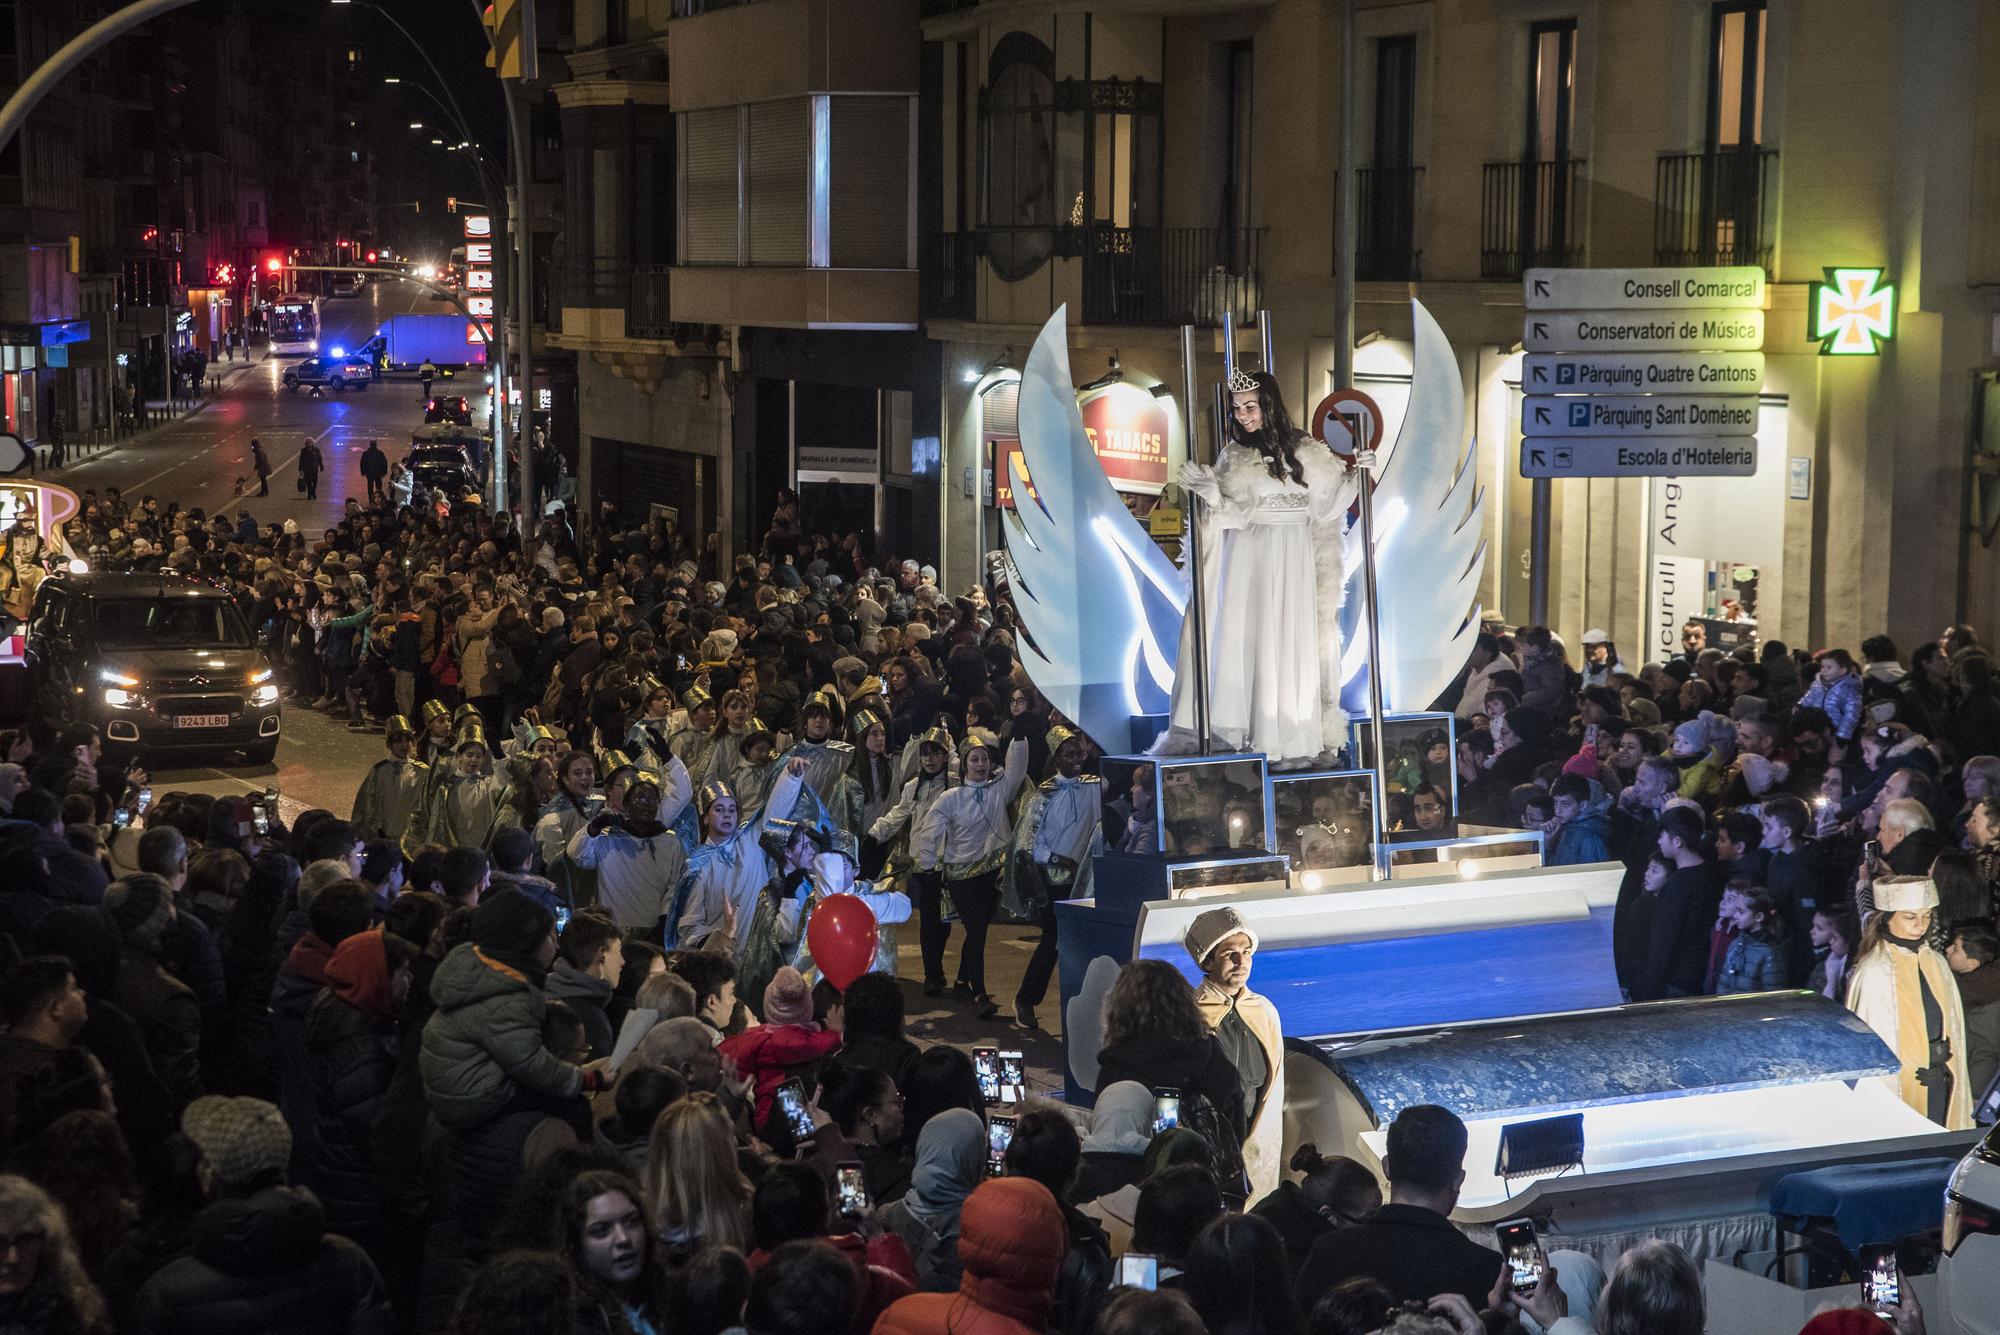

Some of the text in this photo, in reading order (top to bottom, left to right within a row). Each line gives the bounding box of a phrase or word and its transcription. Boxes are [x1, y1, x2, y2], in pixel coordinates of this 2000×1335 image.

[1624, 279, 1756, 298] Consell Comarcal
[1577, 321, 1756, 340] Conservatori de Música
[1560, 364, 1756, 387] P Pàrquing Quatre Cantons
[1572, 404, 1752, 429] P Pàrquing Sant Domènec
[1104, 429, 1161, 454] TABACS
[1617, 448, 1752, 465] Escola d'Hoteleria
[1660, 476, 1682, 546] Ang
[1659, 561, 1676, 666] ucurull
[180, 716, 227, 727] 9243 LBG
